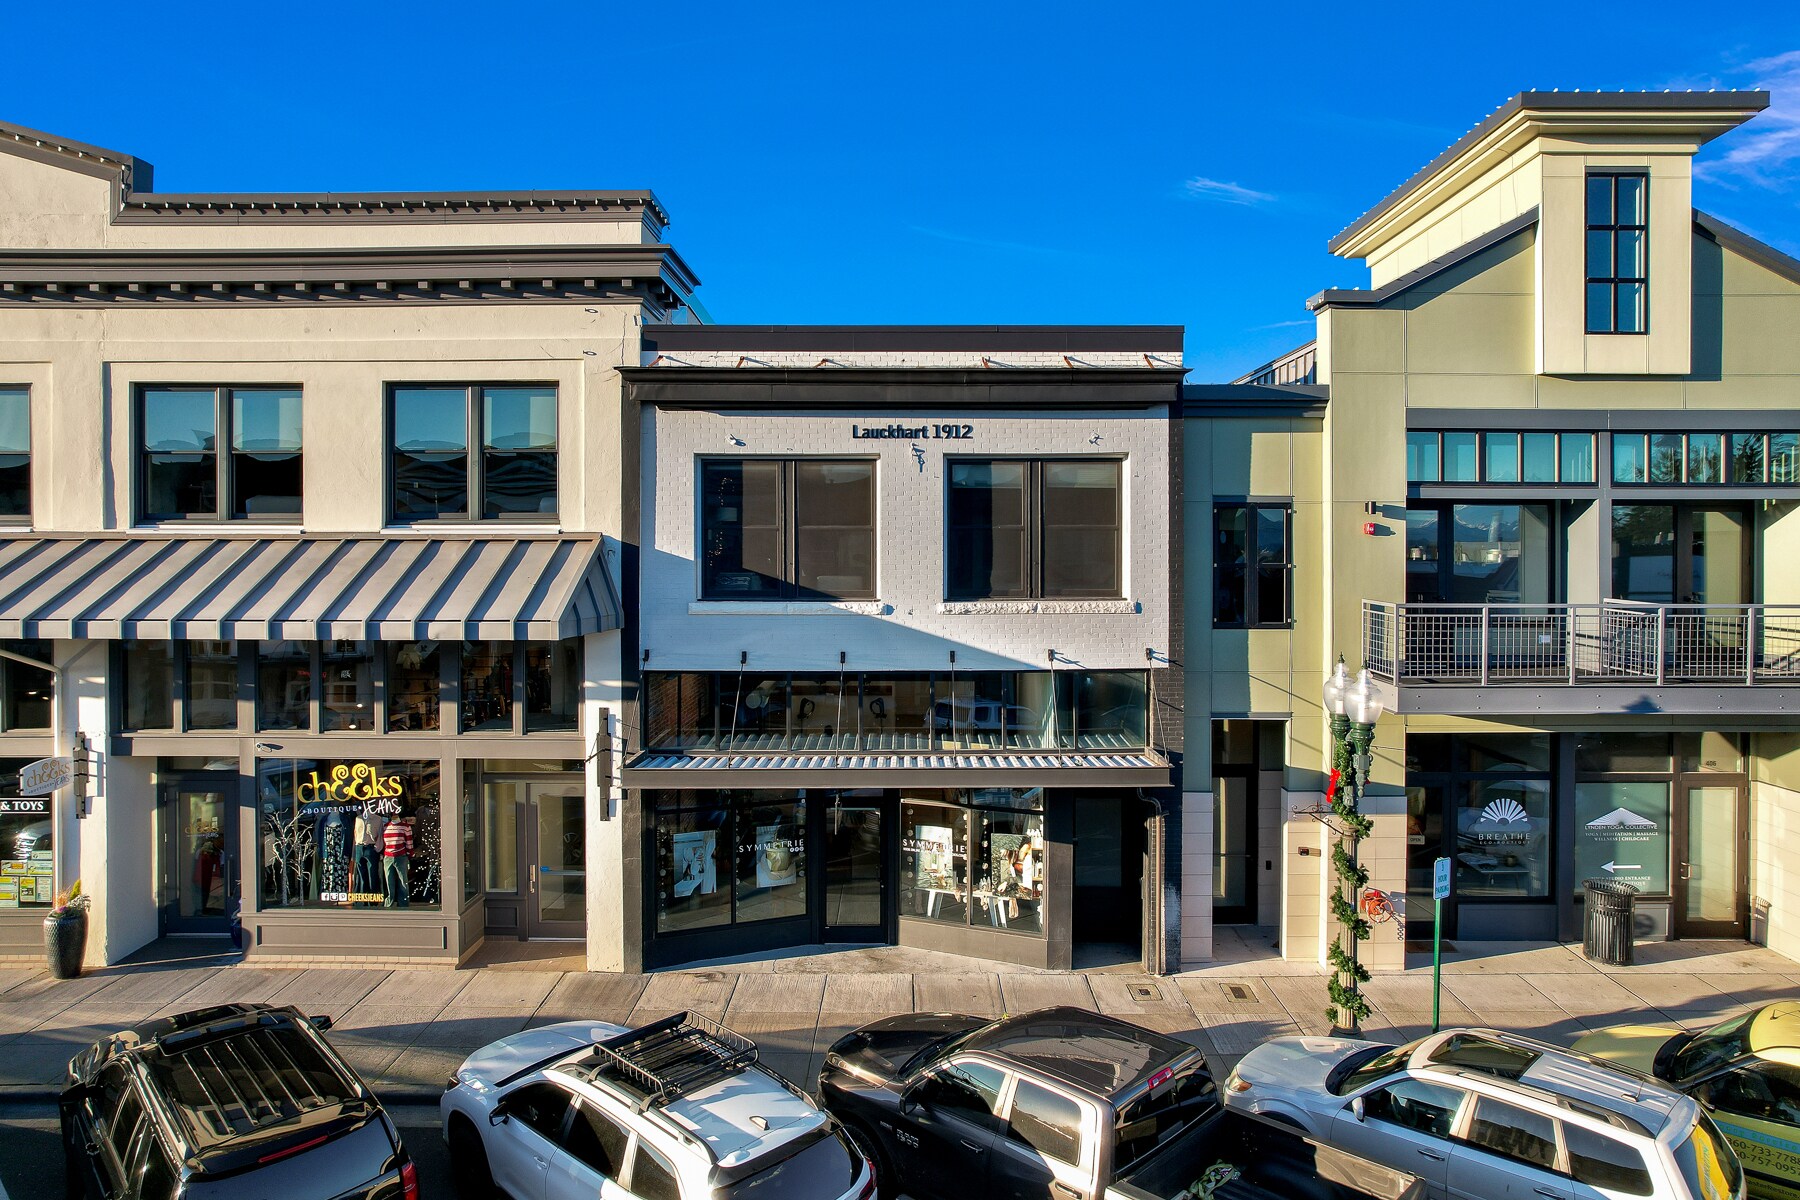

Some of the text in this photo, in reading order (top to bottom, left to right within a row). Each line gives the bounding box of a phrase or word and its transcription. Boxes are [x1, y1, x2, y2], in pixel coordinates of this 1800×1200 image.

[853, 424, 974, 439] Lauckhart 1912
[12, 801, 44, 811] TOYS
[307, 804, 358, 814] BOUTIQUE
